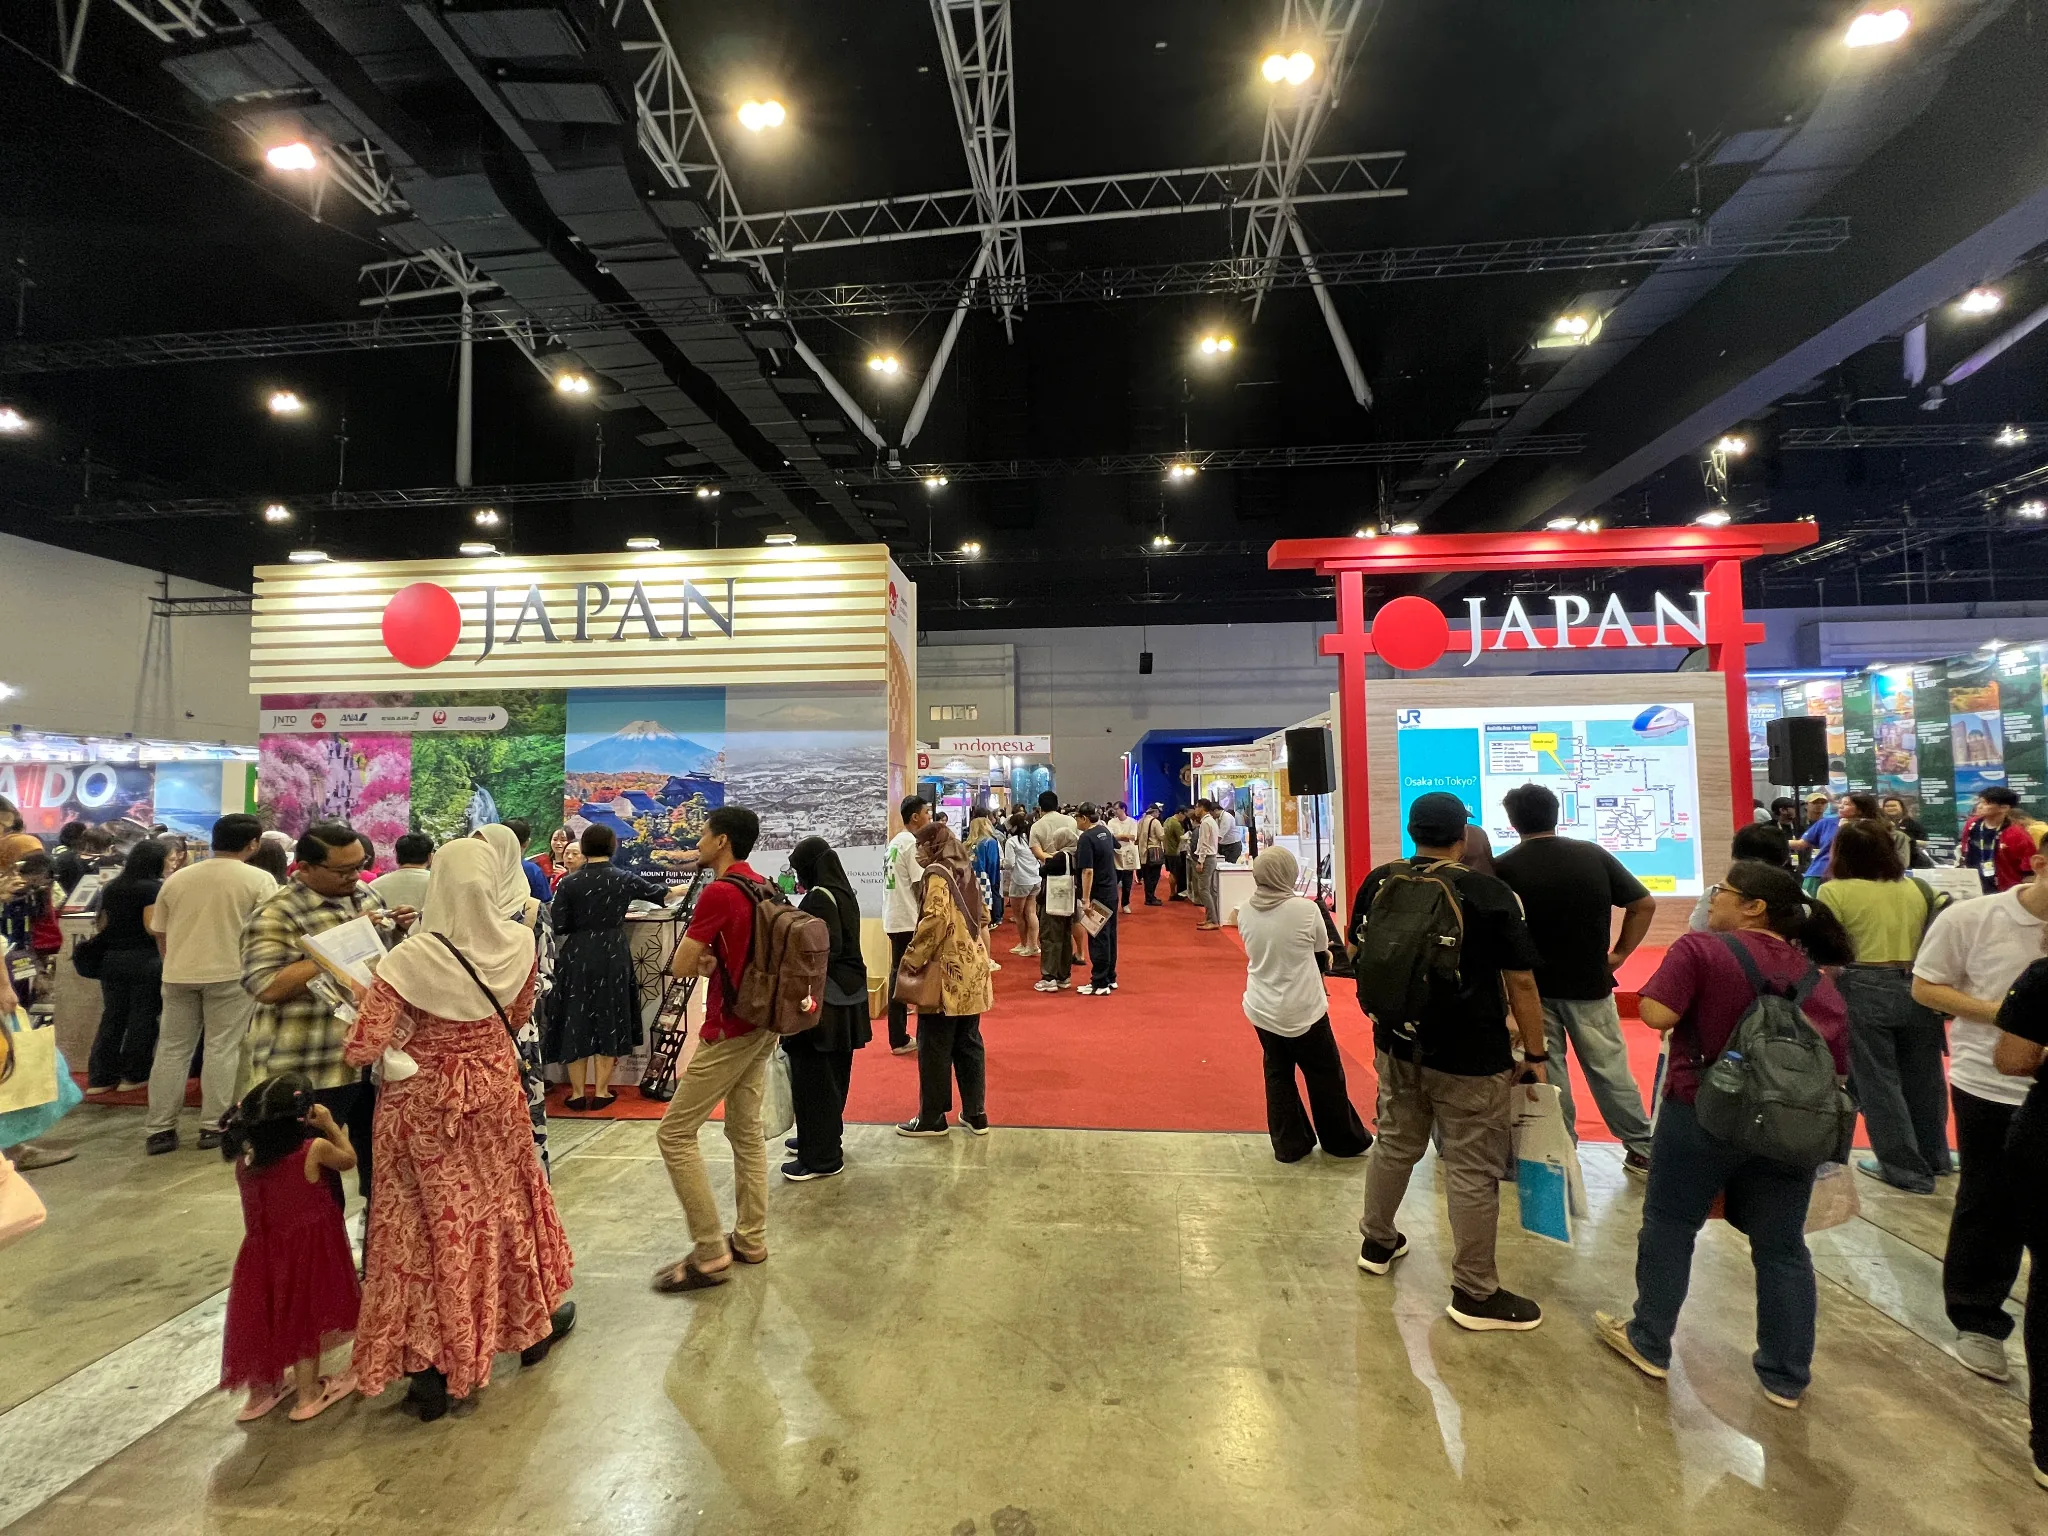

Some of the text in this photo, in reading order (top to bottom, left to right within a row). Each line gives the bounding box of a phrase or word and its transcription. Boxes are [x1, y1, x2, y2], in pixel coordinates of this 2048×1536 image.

[474, 577, 738, 666] JAPAN
[1462, 591, 1711, 667] JAPAN
[273, 715, 298, 729] JNTO
[1398, 709, 1421, 724] JR
[953, 738, 1035, 752] indonesia
[1404, 775, 1477, 788] Osaka to Tokyo?
